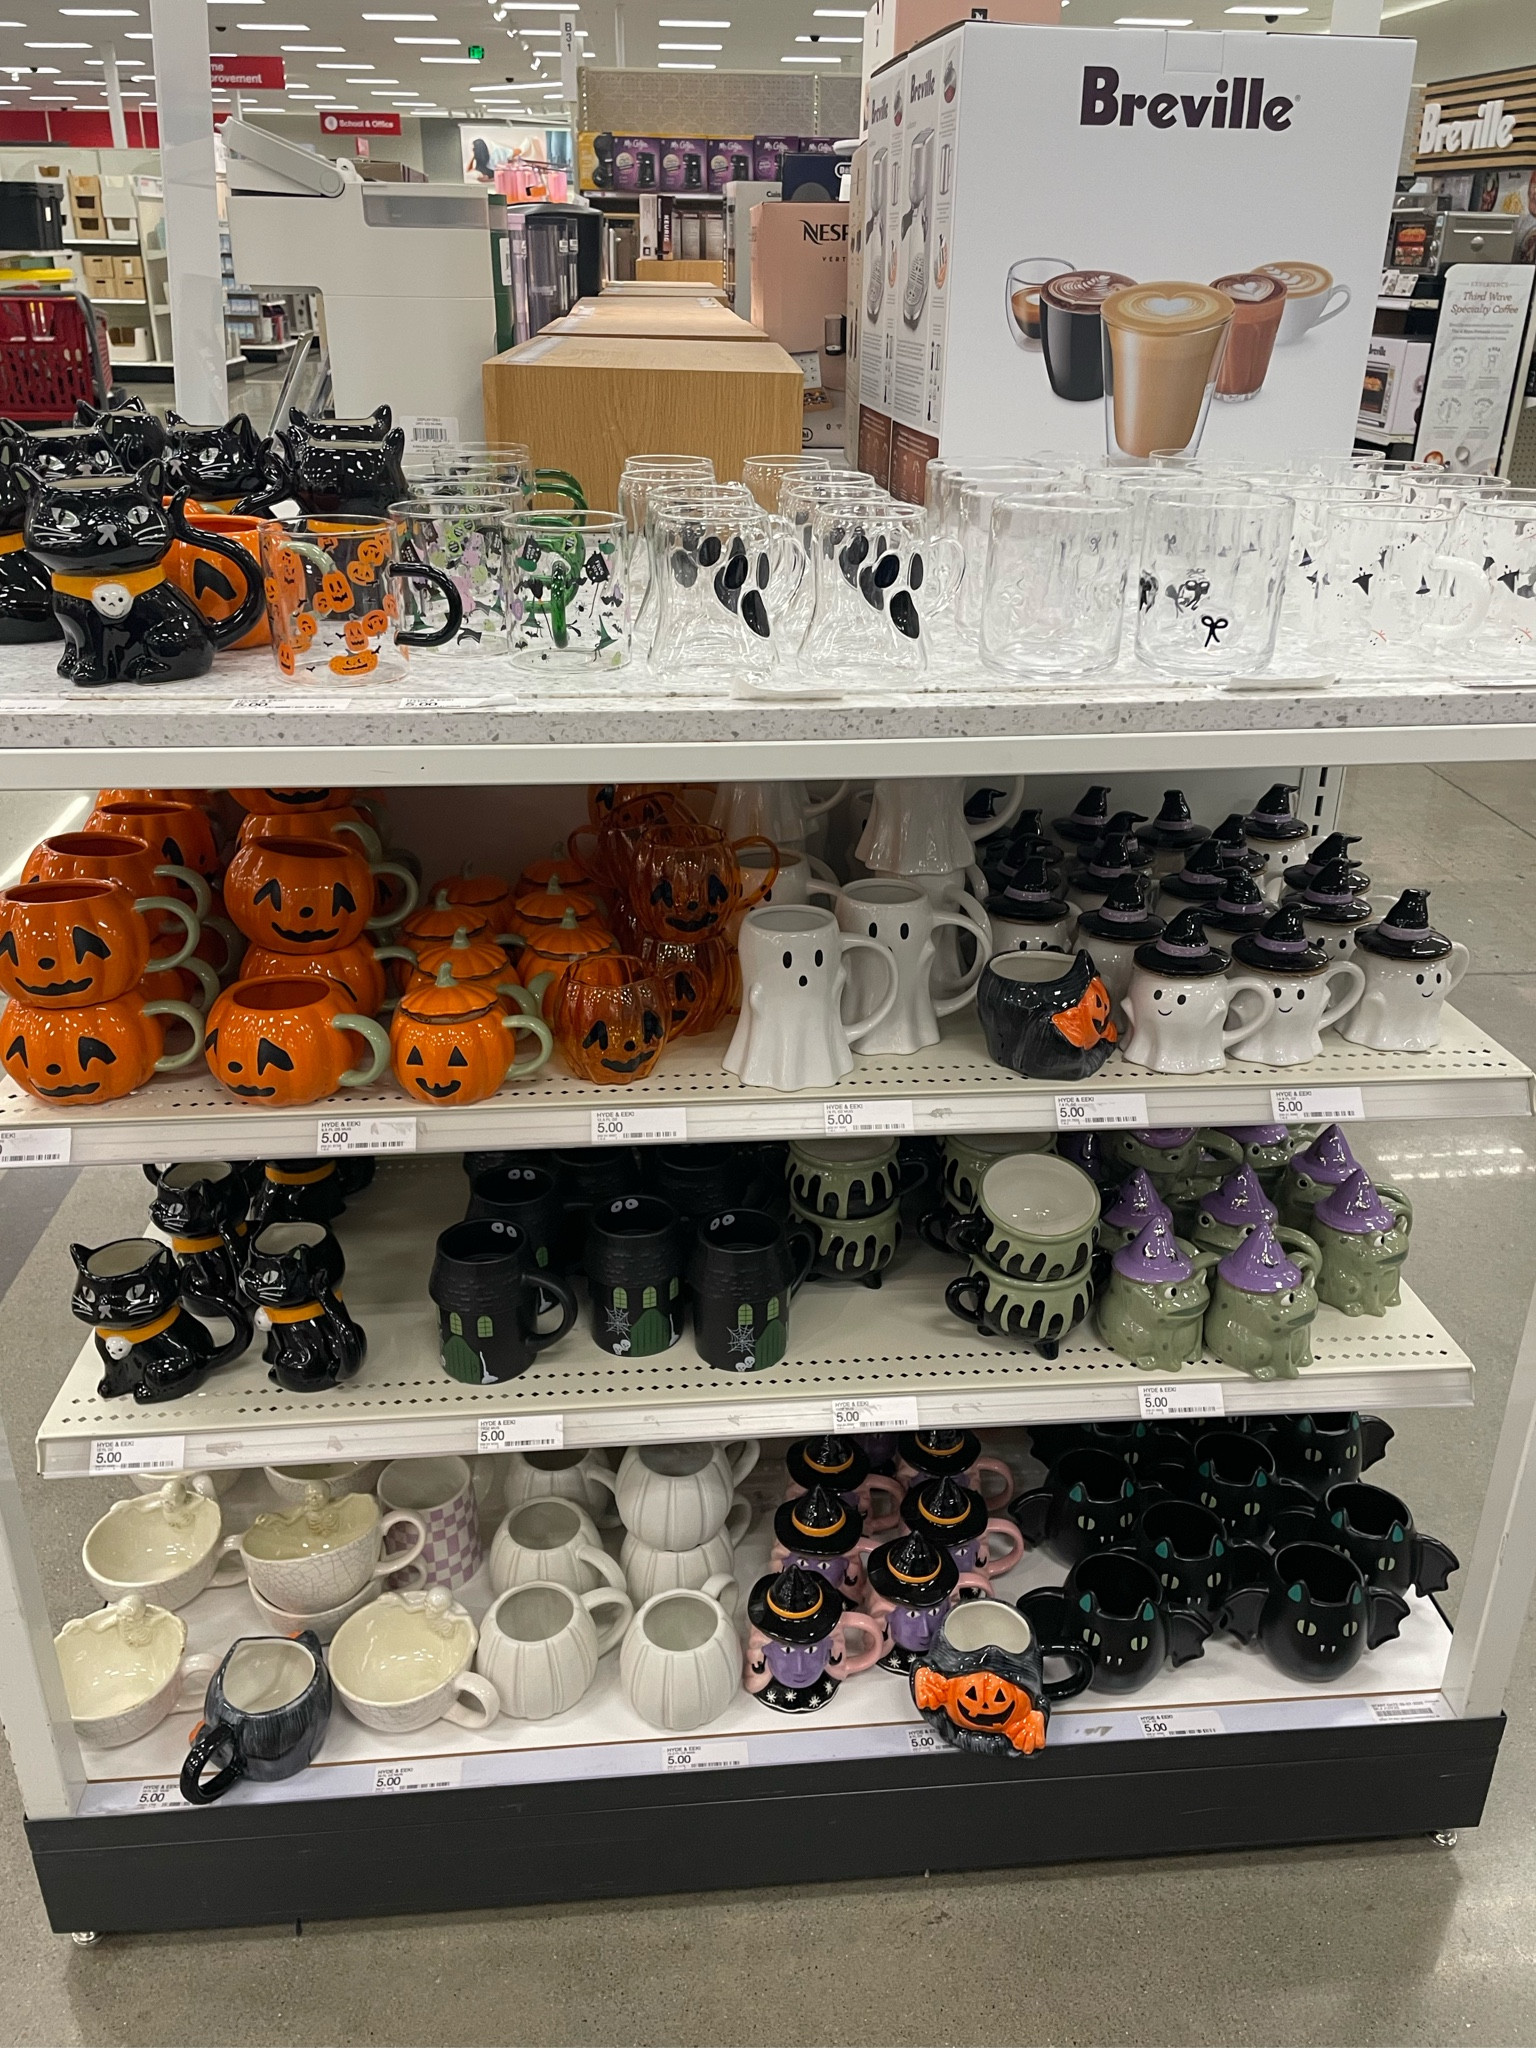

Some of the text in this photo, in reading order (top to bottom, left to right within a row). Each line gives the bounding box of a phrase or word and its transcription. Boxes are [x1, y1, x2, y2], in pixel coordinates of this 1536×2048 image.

[1080, 66, 1294, 132] Breville
[1419, 99, 1516, 154] Breville
[1464, 291, 1512, 301] Third Wave
[1450, 304, 1519, 316] Specialty Coffee
[1278, 1101, 1303, 1112] 5.00
[1060, 1107, 1084, 1118] 5.00
[827, 1114, 852, 1125] 5.00
[597, 1122, 623, 1133] 5.00
[321, 1132, 348, 1143] 5.00
[1145, 1397, 1168, 1408] 5.00
[836, 1411, 859, 1422] 5.00
[480, 1430, 505, 1441] 5.00
[96, 1452, 122, 1464] 5.00
[1144, 1722, 1167, 1732] 5.00
[911, 1737, 934, 1747] 5.00
[668, 1755, 691, 1764] 5.00
[376, 1777, 401, 1787] 5.00
[139, 1793, 165, 1803] 5.00
